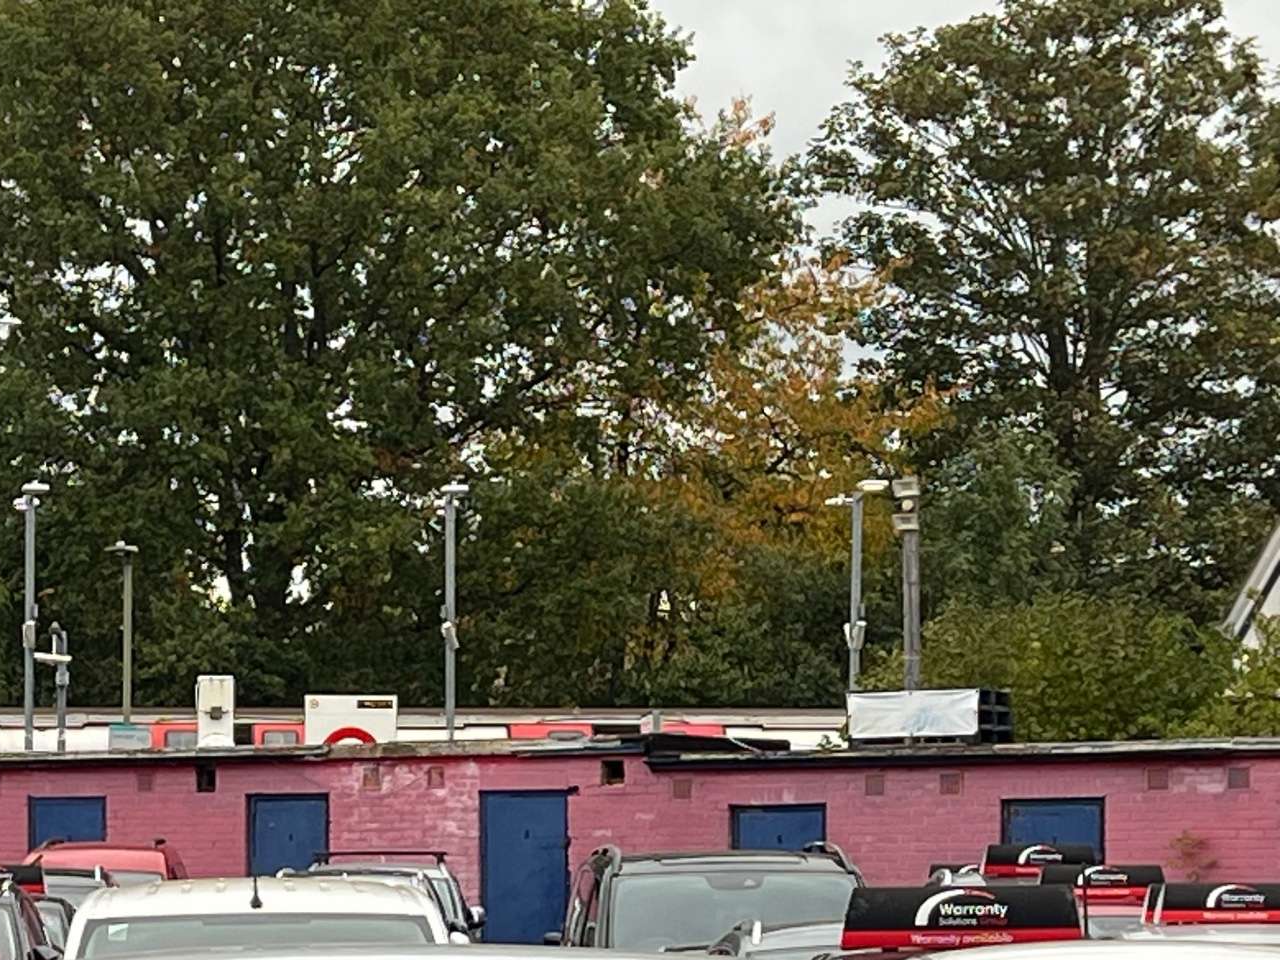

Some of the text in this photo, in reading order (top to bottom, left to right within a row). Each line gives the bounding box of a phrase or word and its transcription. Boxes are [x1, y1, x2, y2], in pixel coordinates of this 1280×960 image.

[939, 903, 1008, 918] Warranty
[910, 931, 1014, 946] Warranty available
